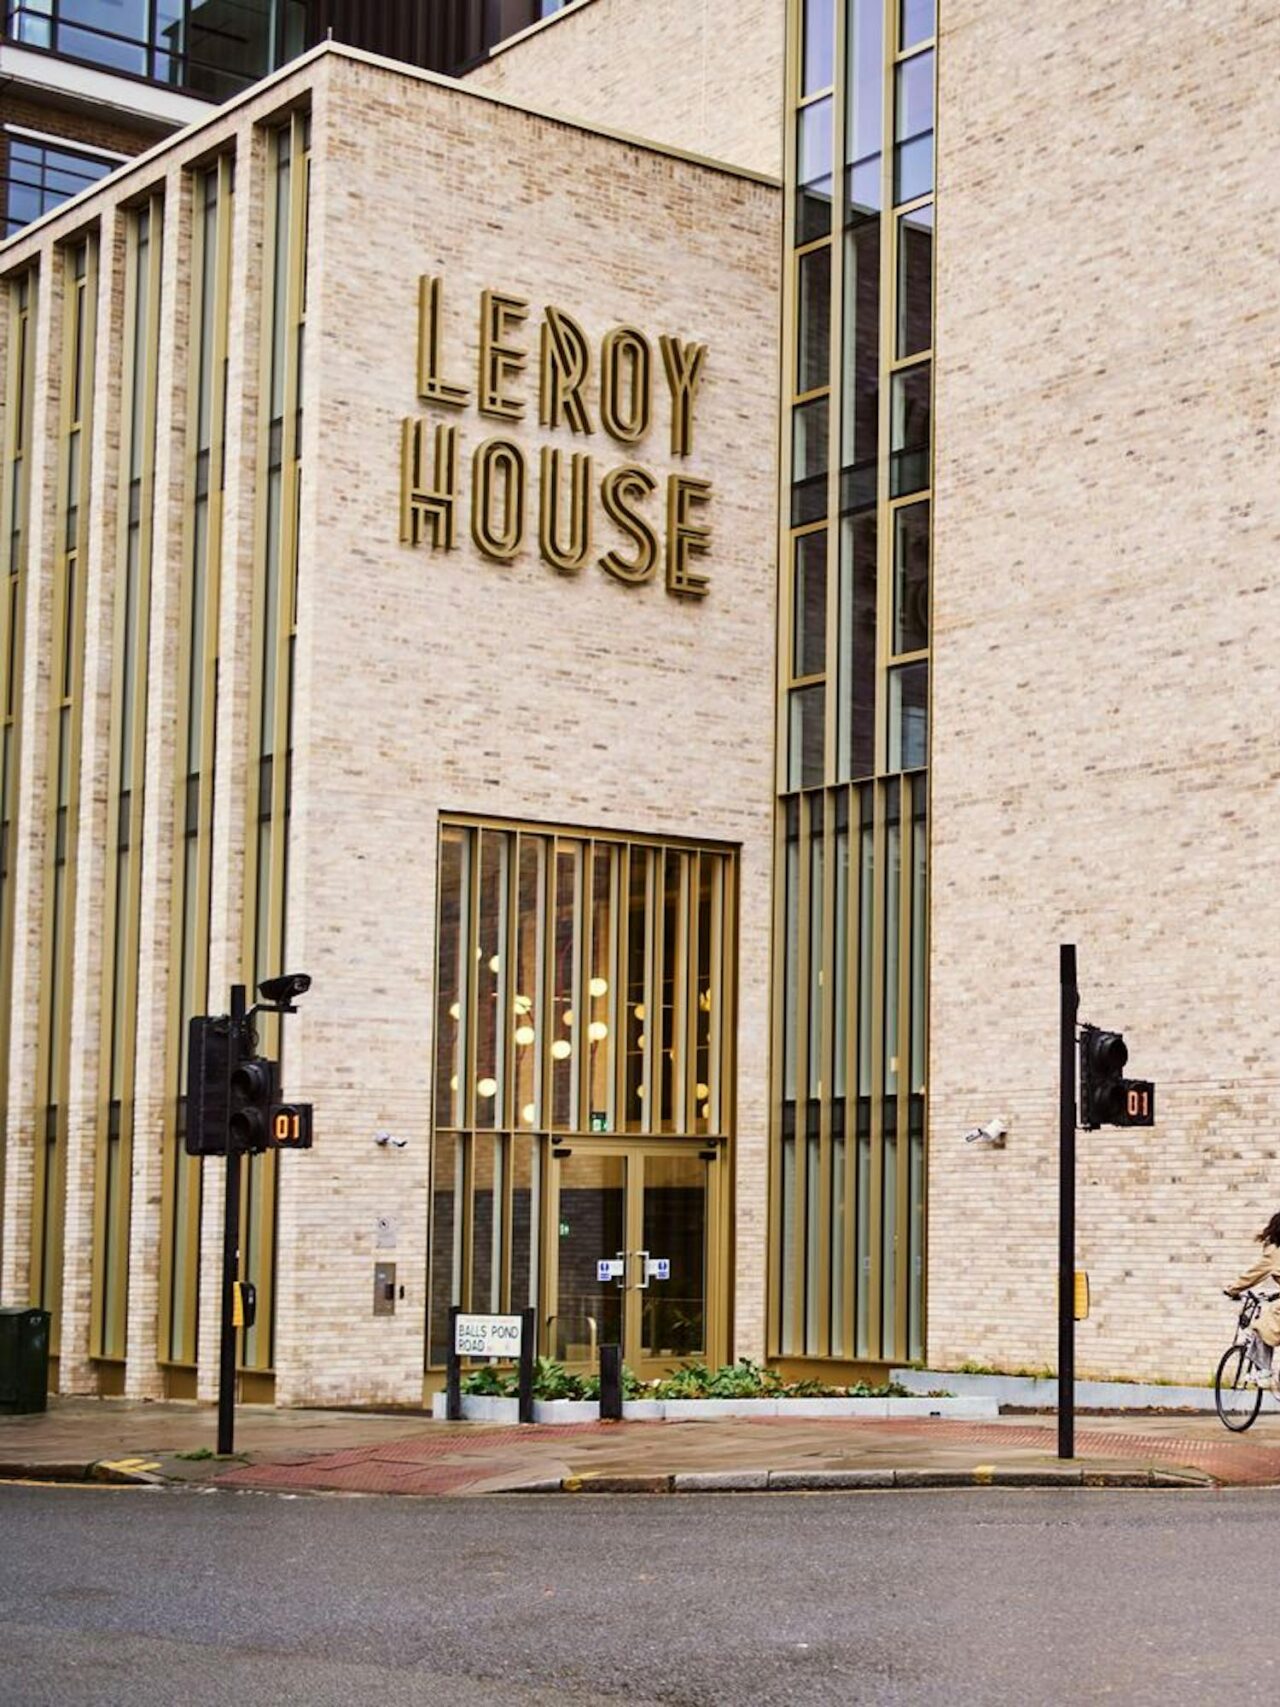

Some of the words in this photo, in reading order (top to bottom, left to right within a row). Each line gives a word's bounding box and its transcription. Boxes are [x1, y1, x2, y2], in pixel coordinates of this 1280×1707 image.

[417, 273, 709, 457] LEROY
[399, 416, 713, 597] HOUSE
[1127, 1090, 1148, 1117] 01
[276, 1114, 300, 1140] 01
[458, 1324, 487, 1338] BALLS
[491, 1325, 519, 1339] POND
[458, 1339, 485, 1352] ROAD
